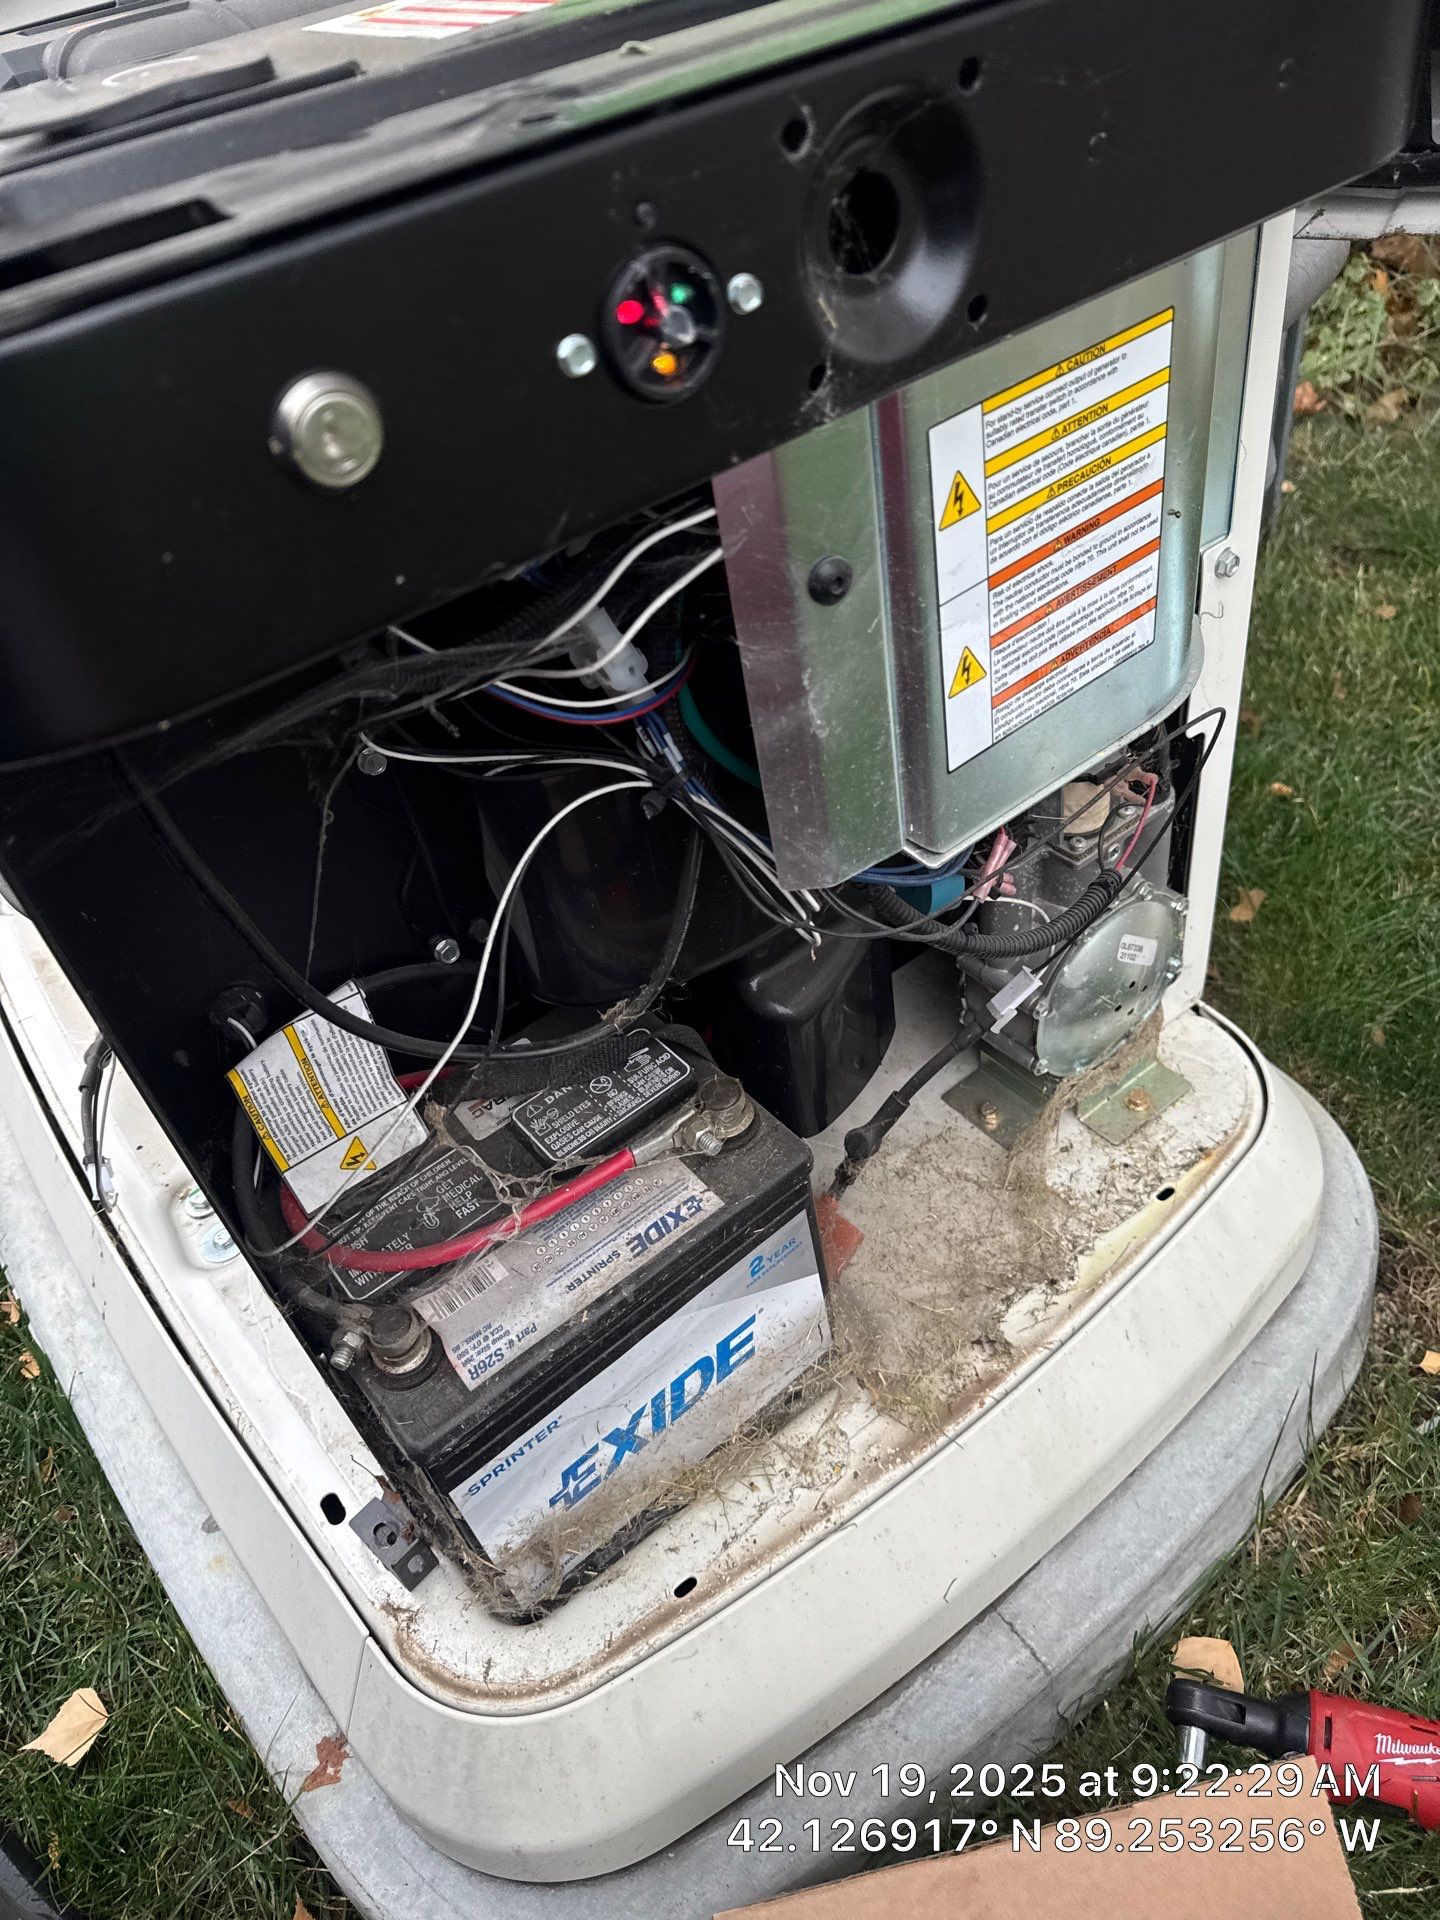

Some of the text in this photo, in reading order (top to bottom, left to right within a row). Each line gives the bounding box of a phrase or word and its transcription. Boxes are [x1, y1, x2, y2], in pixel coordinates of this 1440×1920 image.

[1067, 344, 1105, 371] CAUTION
[986, 351, 1126, 429] For stand-by service connect output of generator to
[986, 365, 1117, 440] suitably rated transfer switch in accordance with
[986, 396, 1076, 448] Canadian electrical code, part 1.
[1062, 402, 1107, 434] ATTENTION
[1057, 455, 1111, 493] PRECAUCIÓN
[1064, 517, 1100, 544] WARNING
[993, 598, 1002, 608] The
[1004, 586, 1022, 602] neutral
[1024, 571, 1049, 591] conductor
[1051, 563, 1063, 575] must
[1065, 558, 1071, 567] be
[1073, 546, 1091, 562] bonded
[1099, 532, 1115, 547] ground
[1117, 528, 1122, 536] in
[1123, 512, 1151, 533] accordance
[993, 607, 1003, 618] with
[1005, 601, 1013, 611] the
[1015, 589, 1034, 605] national
[1037, 574, 1059, 593] electrical
[1061, 566, 1072, 578] code
[1096, 547, 1106, 558] This
[1108, 541, 1116, 551] unit
[1118, 534, 1128, 545] shall
[1130, 528, 1138, 538] not
[1139, 524, 1145, 533] be
[1147, 516, 1158, 528] used
[993, 558, 1053, 600] Risk of electrical shock.
[1056, 564, 1116, 606] AVERTISSEMENT
[994, 578, 1068, 627] in floating output applications.
[1060, 626, 1110, 663] ADVERTENCIA
[239, 1068, 253, 1090] system:
[300, 1057, 325, 1100] ATTENTION
[627, 1052, 670, 1084] SULFURIC ACID
[632, 1067, 662, 1088] CAN CAUSE
[638, 1066, 674, 1093] BLINDNESS OR
[267, 1077, 286, 1105] connecting
[274, 1074, 287, 1094] polarity.
[607, 1088, 618, 1098] NO
[643, 1069, 681, 1097] SEVERE BURNS
[250, 1090, 263, 1109] control
[283, 1094, 296, 1113] battery
[607, 1090, 628, 1106] SPARKS
[611, 1094, 634, 1111] FLAMES
[616, 1096, 642, 1116] SMOKING
[241, 1094, 265, 1131] CAUTION
[285, 1111, 301, 1134] servicing
[293, 1112, 306, 1131] reverse
[551, 1099, 591, 1128] SHIELD EYES
[264, 1116, 279, 1138] damage
[304, 1131, 315, 1147] Never
[544, 1118, 579, 1144] EXPLOSIVE
[550, 1112, 603, 1150] GASES CAN CAUSE
[556, 1116, 612, 1157] BLINDNESS OR INJURY
[276, 1138, 287, 1153] avoid
[297, 1134, 310, 1151] before
[435, 1169, 449, 1181] AND
[435, 1178, 455, 1194] GET
[442, 1172, 482, 1202] MEDICAL
[365, 1208, 376, 1218] OF
[375, 1200, 388, 1211] THE
[410, 1178, 421, 1187] OF
[449, 1190, 474, 1210] HELP
[455, 1198, 480, 1218] FAST
[622, 1192, 707, 1258] EXIDE
[565, 1249, 620, 1291] SPRINTER
[744, 1237, 797, 1276] 2 YEAR
[745, 1241, 803, 1288] FREE REPLACEMENT
[481, 1322, 492, 1332] RC
[481, 1334, 489, 1342] @
[489, 1324, 503, 1336] CCA
[455, 1348, 469, 1360] 550
[460, 1329, 510, 1367] Group Size: 26R
[466, 1322, 538, 1380] Part #: S26R
[549, 1314, 755, 1510] EXIDE
[468, 1419, 559, 1497] SPRINTER
[1374, 1733, 1440, 1757] Milwauke
